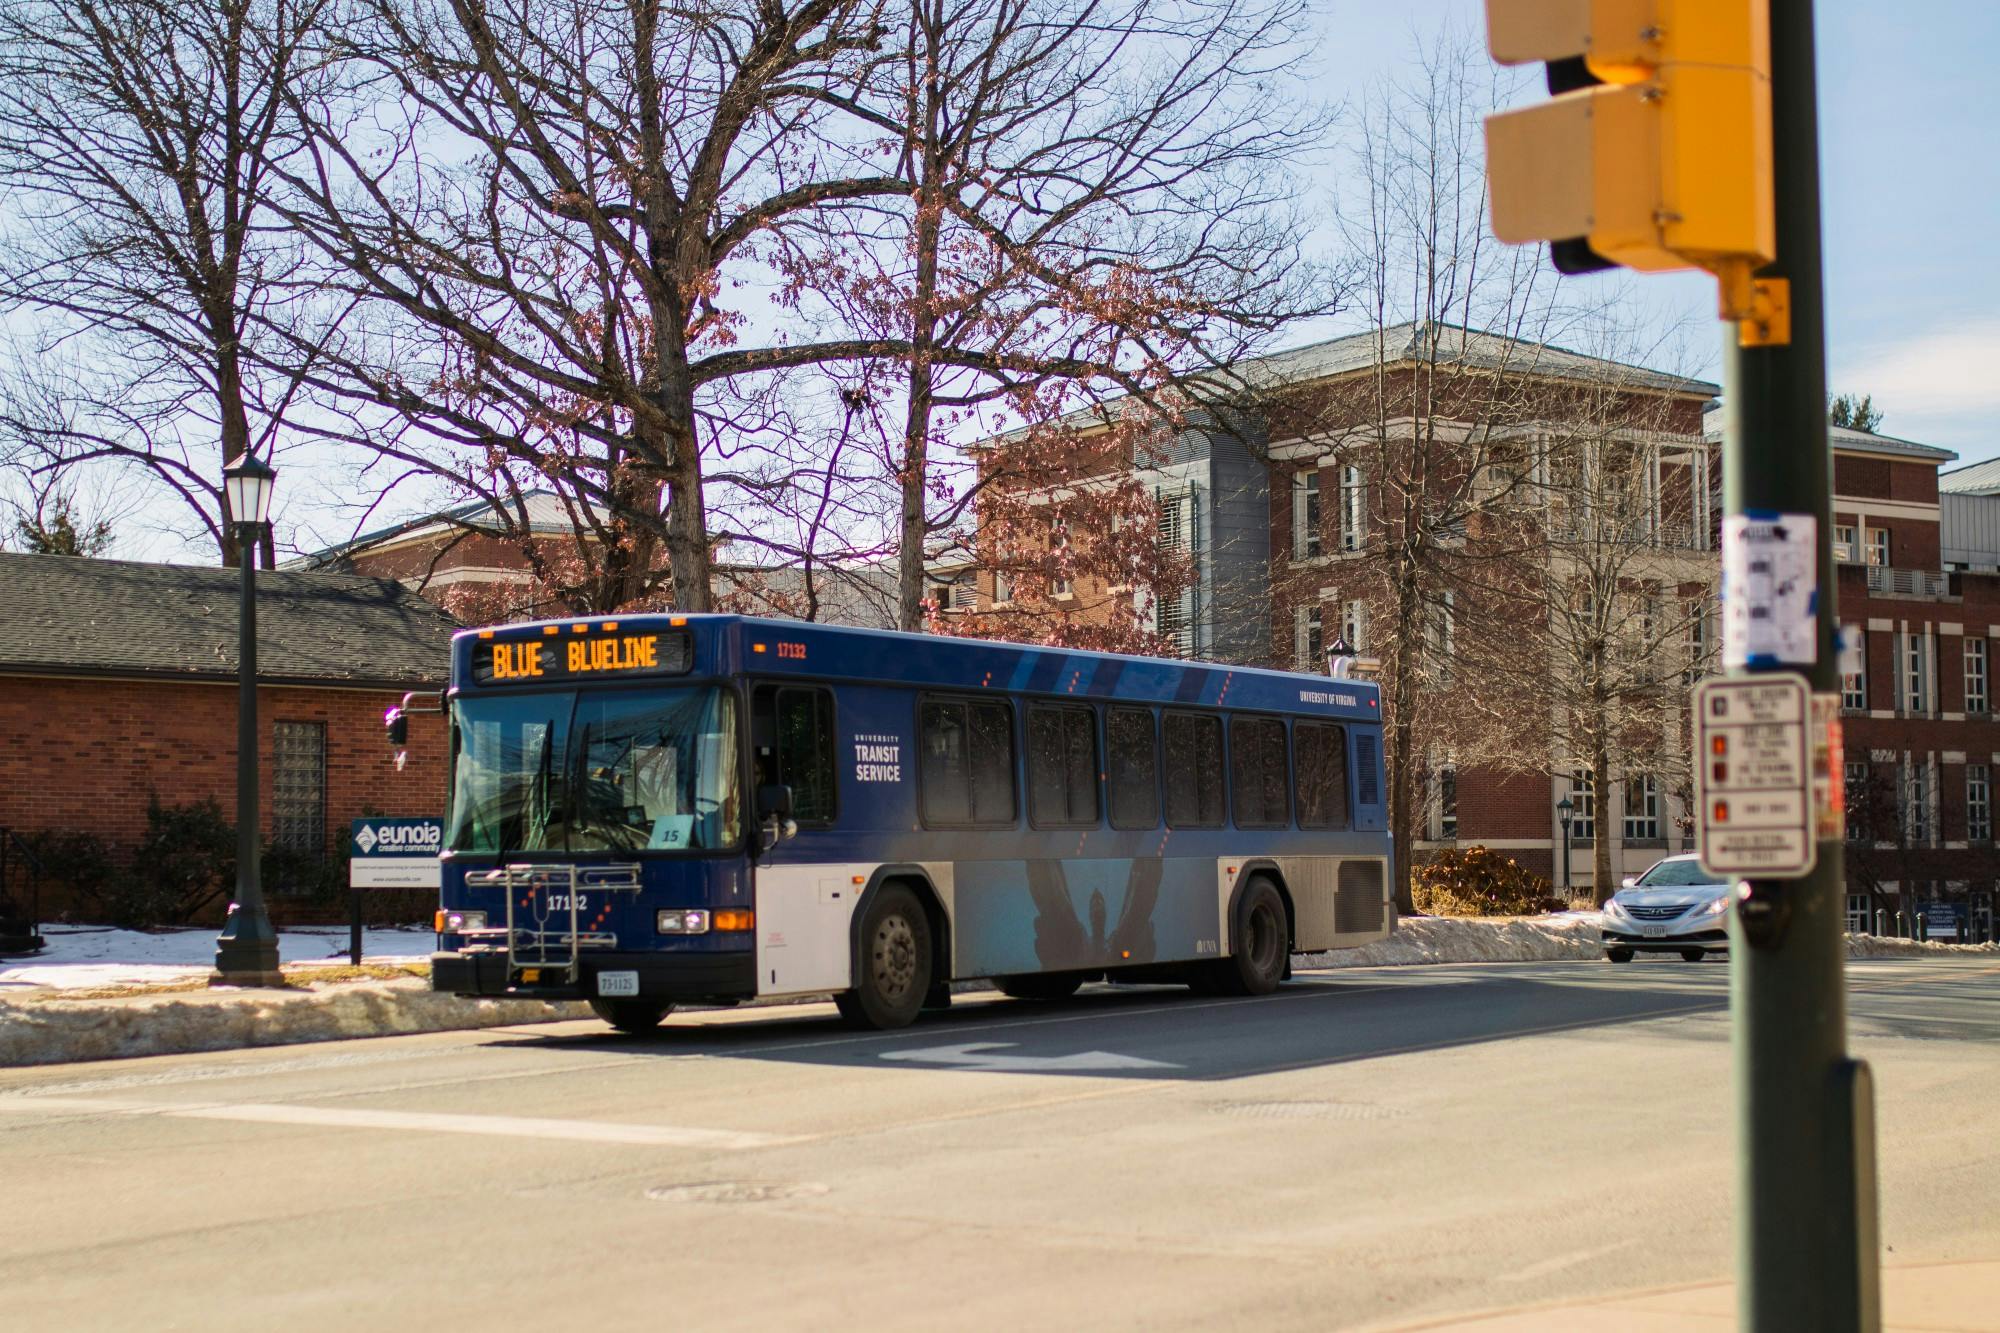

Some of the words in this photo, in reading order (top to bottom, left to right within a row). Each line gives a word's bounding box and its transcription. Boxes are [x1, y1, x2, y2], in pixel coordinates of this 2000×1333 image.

[492, 642, 544, 678] BLUE
[567, 636, 658, 672] BLUELINE
[778, 642, 806, 658] 17132
[1300, 691, 1327, 703] UNIVERSITY
[1329, 694, 1335, 704] OF
[1336, 695, 1356, 706] VIRGINIA
[855, 734, 899, 742] UNIVERSITY
[855, 745, 899, 762] TRANSIT
[856, 765, 901, 781] SERVICE
[378, 821, 440, 844] eunoia
[662, 830, 679, 842] 15
[378, 844, 403, 852] creative
[404, 844, 440, 853] community
